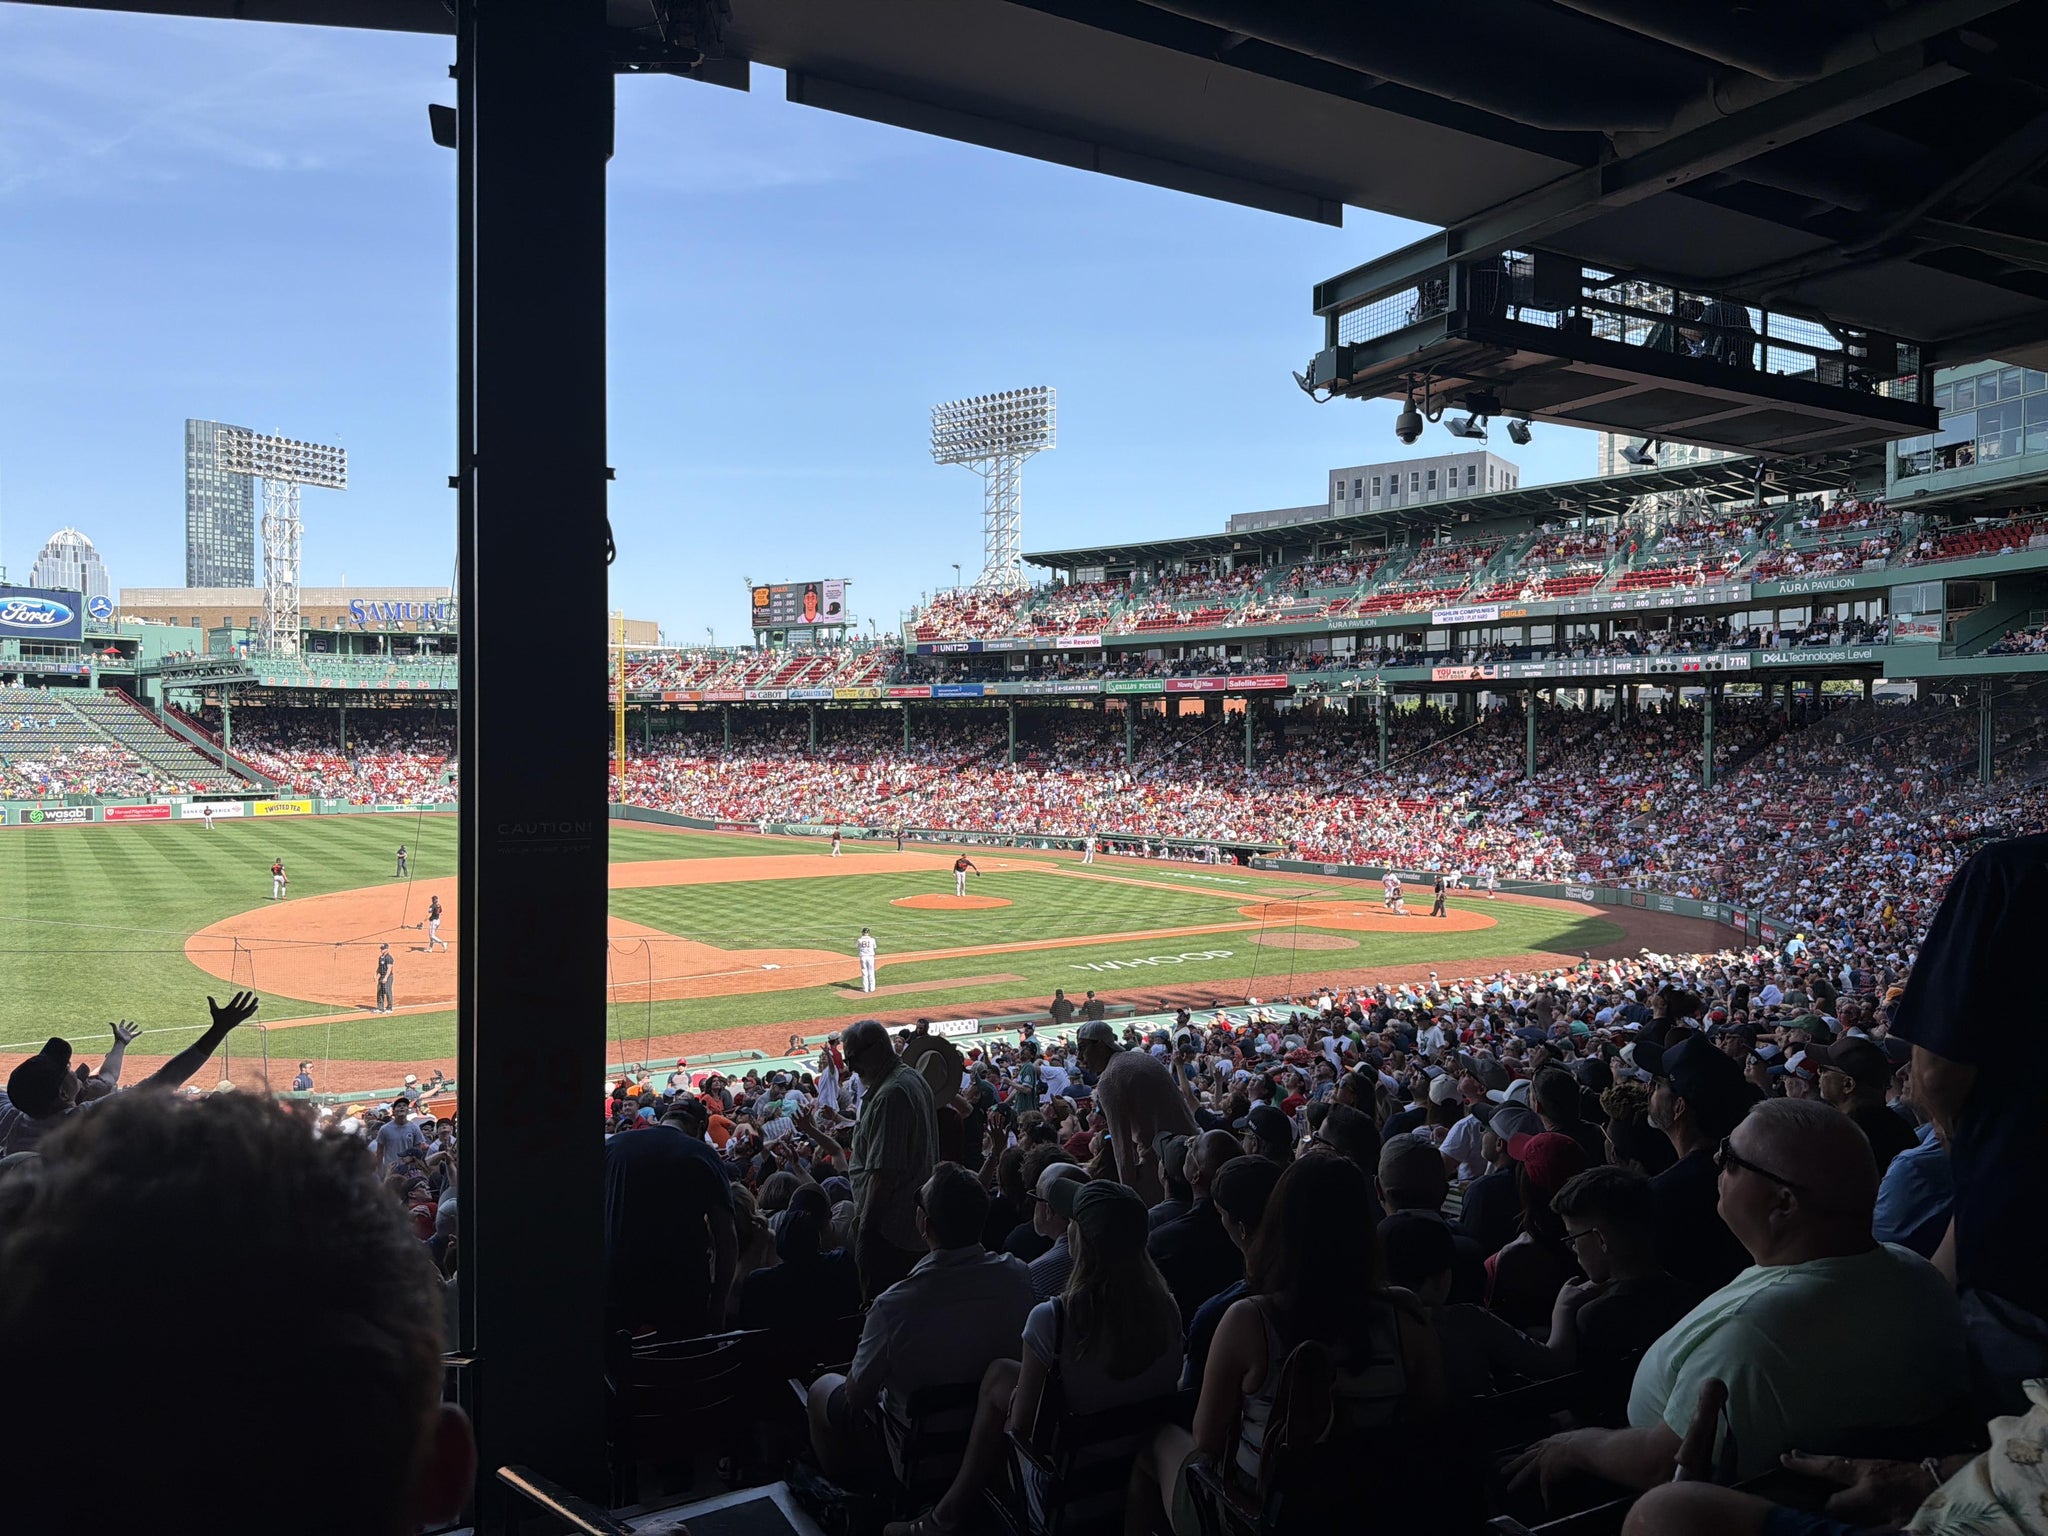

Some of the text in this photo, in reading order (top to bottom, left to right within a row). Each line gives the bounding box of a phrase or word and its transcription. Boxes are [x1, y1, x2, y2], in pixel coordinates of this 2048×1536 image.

[1811, 578, 1855, 590] PAVILION
[1658, 598, 1674, 606] .000
[1682, 596, 1697, 604] .000
[1, 601, 56, 623] Ford
[1501, 610, 1527, 618] SEIGLER
[1350, 618, 1377, 627] PAVILION
[940, 644, 969, 652] UNITED
[1763, 649, 1872, 663] DELL Technologies Level
[1729, 657, 1747, 666] 7TH
[1437, 668, 1451, 676] YOU
[376, 680, 390, 689] 45
[397, 680, 410, 689] 26
[1229, 680, 1257, 688] Safelite
[264, 804, 301, 813] TWISTED TEA
[45, 808, 86, 819] wasabi
[1069, 950, 1234, 972] WHOOP
